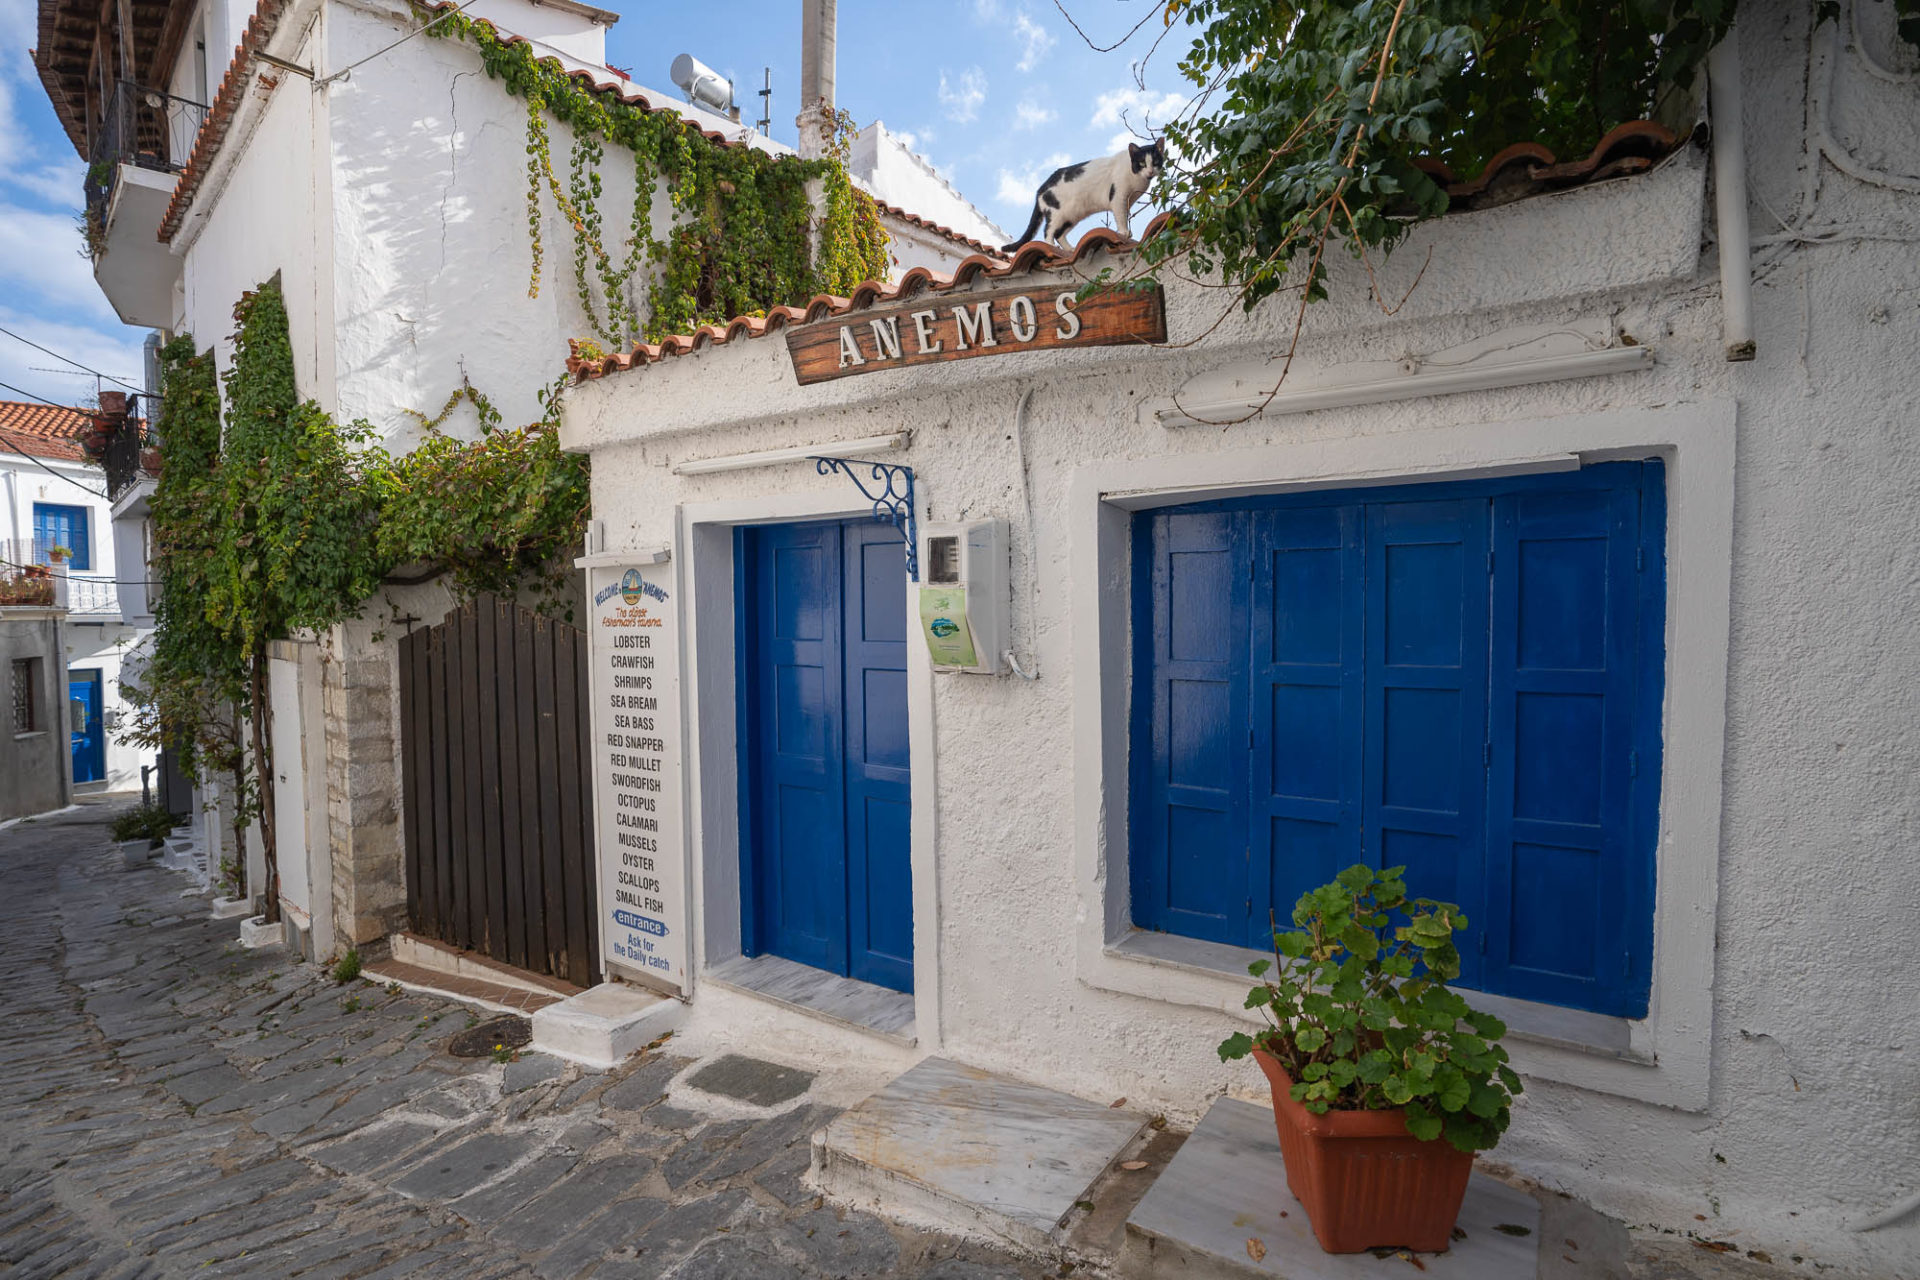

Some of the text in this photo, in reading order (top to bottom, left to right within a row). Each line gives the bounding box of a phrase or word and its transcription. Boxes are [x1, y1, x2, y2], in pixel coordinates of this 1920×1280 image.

[838, 291, 1081, 368] ANEMOS
[594, 582, 618, 607] WELCOME
[616, 606, 626, 618] The
[614, 635, 650, 649] LOBSTER
[611, 655, 654, 669] CRAWFISH
[614, 676, 652, 690] SHRIMPS
[610, 695, 657, 711] SEA BREAM
[614, 715, 654, 730] SEA BASS
[608, 734, 663, 752] RED SNAPPER
[611, 754, 661, 771] RED MULLET
[612, 773, 661, 792] SWORDFISH
[618, 793, 655, 812] OCTOPUS
[617, 813, 658, 832] CALAMARI
[619, 832, 657, 852] MUSSELS
[623, 852, 654, 871] OYSTER
[618, 871, 660, 893] SCALLOPS
[616, 890, 664, 914] SMALL FISH
[618, 912, 661, 934] entrance
[628, 933, 654, 952] Ask for
[614, 942, 669, 971] the Daily catch
